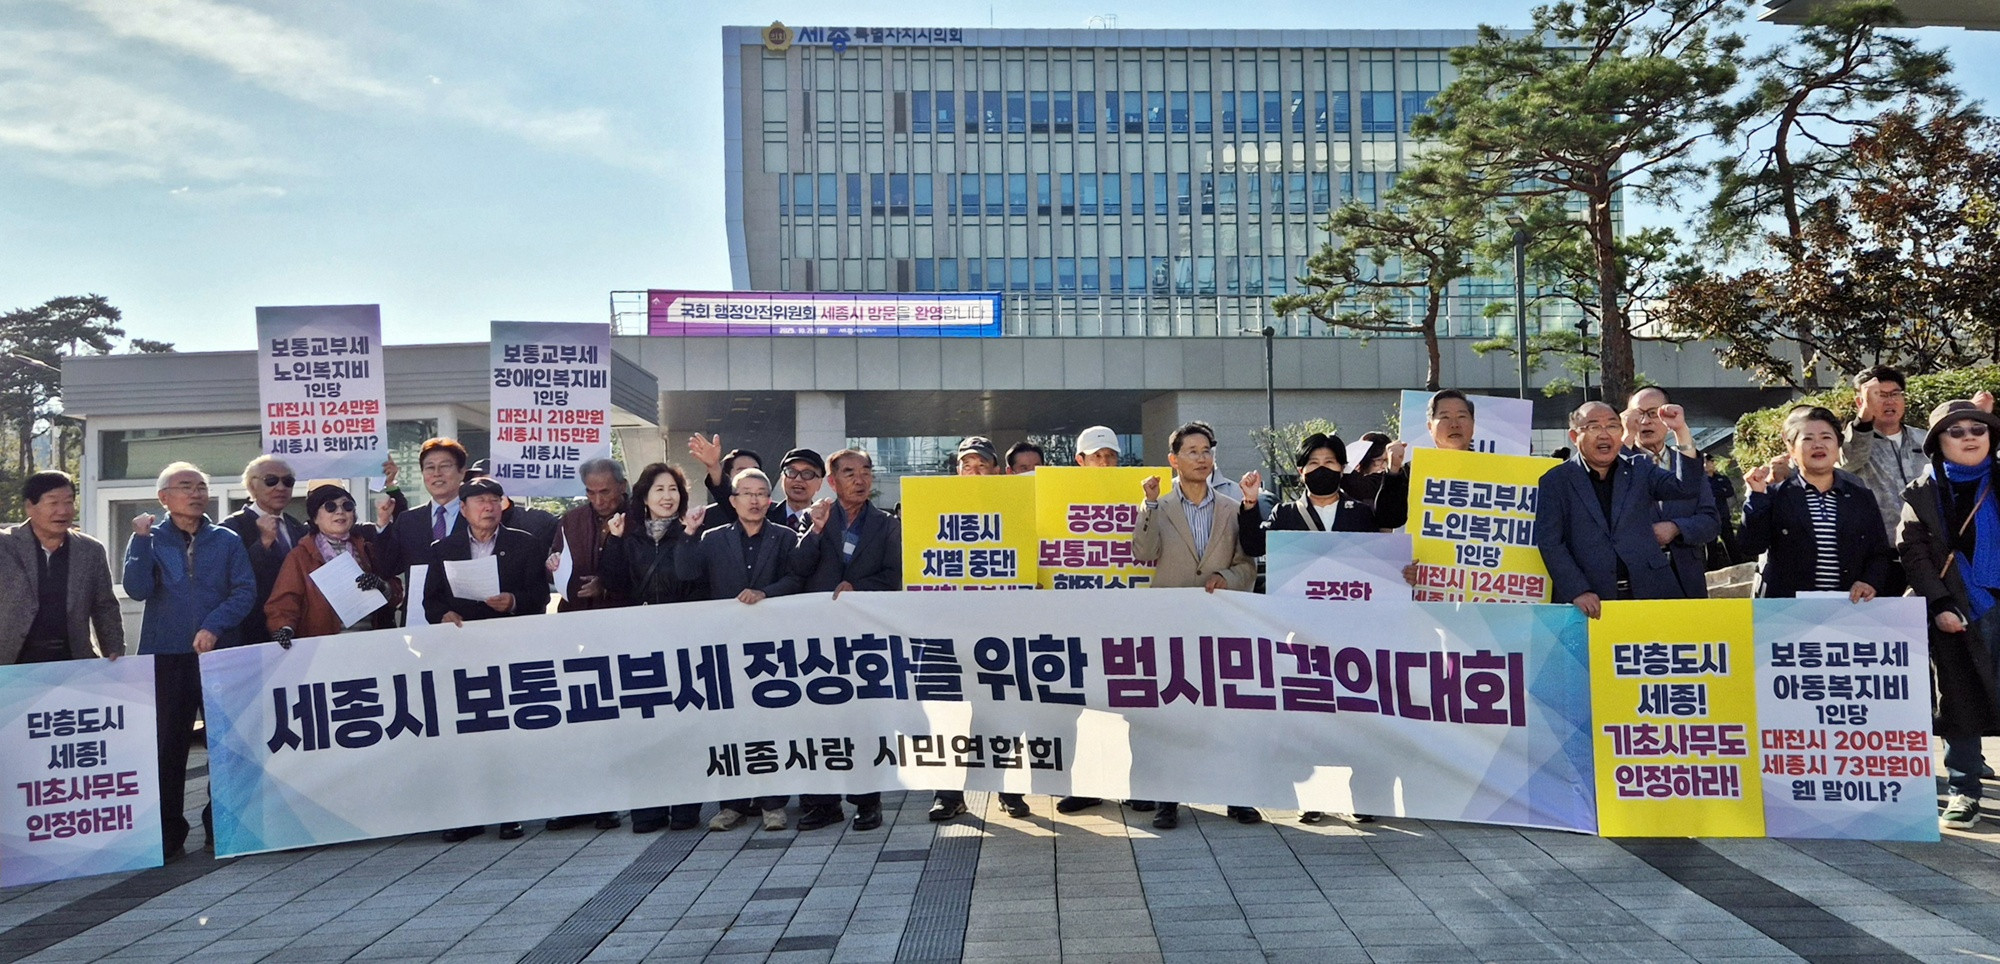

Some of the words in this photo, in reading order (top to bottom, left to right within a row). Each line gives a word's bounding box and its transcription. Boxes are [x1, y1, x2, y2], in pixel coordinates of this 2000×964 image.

[681, 303, 710, 319] 국회
[714, 304, 817, 321] 행정안전위원회
[821, 305, 864, 321] 세종시
[868, 305, 910, 321] 방문을
[271, 336, 369, 357] 보통교부세
[504, 345, 598, 364] 보통교부세
[274, 360, 369, 381] 노인복지비
[494, 368, 607, 389] 장애인복지비
[304, 382, 342, 398] 1인당
[533, 390, 569, 406] 1인당
[268, 401, 315, 418] 대전시
[320, 399, 379, 416] 124만원
[497, 408, 542, 425] 대전시
[548, 409, 604, 425] 218만원
[268, 420, 316, 437] 세종시
[322, 417, 375, 434] 60만원
[497, 426, 542, 442] 세종시
[547, 428, 600, 443] 115만원
[272, 437, 318, 455] 세종시
[323, 435, 378, 453] 핫바지?
[521, 446, 580, 460] 세종시는
[496, 464, 541, 479] 세금만
[546, 464, 575, 479] 내는
[937, 514, 1000, 541] 세종시
[1068, 504, 1138, 532] 공정한
[1422, 512, 1539, 546] 노인복지비
[923, 549, 963, 577] 차별
[969, 549, 1016, 577] 중단!
[1039, 540, 1158, 568] 보통교부
[1456, 544, 1501, 568] 1인당
[1471, 571, 1544, 598] 124만원
[1614, 643, 1727, 676] 단층도시
[1771, 642, 1909, 668] 보통교부세
[266, 670, 441, 754] 세종시
[454, 643, 734, 735] 보통교부세
[743, 633, 963, 708] 정상화를
[974, 634, 1088, 706] 위한
[1101, 634, 1526, 728] 범시민결의대회
[1638, 684, 1706, 715] 세종!
[1773, 675, 1909, 700] 아동복지비
[27, 705, 125, 739] 단층도시
[1816, 705, 1868, 725] 1인당
[1604, 725, 1746, 756] 기초사무도
[1761, 730, 1827, 751] 대전시
[1834, 730, 1928, 752] 200만원
[47, 740, 107, 770] 세종!
[706, 737, 855, 778] 세종사랑
[873, 734, 1064, 771] 시민연합회
[1761, 754, 1827, 776] 세종시
[1834, 755, 1931, 777] 73만원이
[17, 771, 139, 807] 기초사무도
[1615, 765, 1739, 798] 인정하라!
[1792, 781, 1816, 801] 웬
[1823, 781, 1902, 802] 말이냐?
[26, 804, 133, 842] 인정하라!
